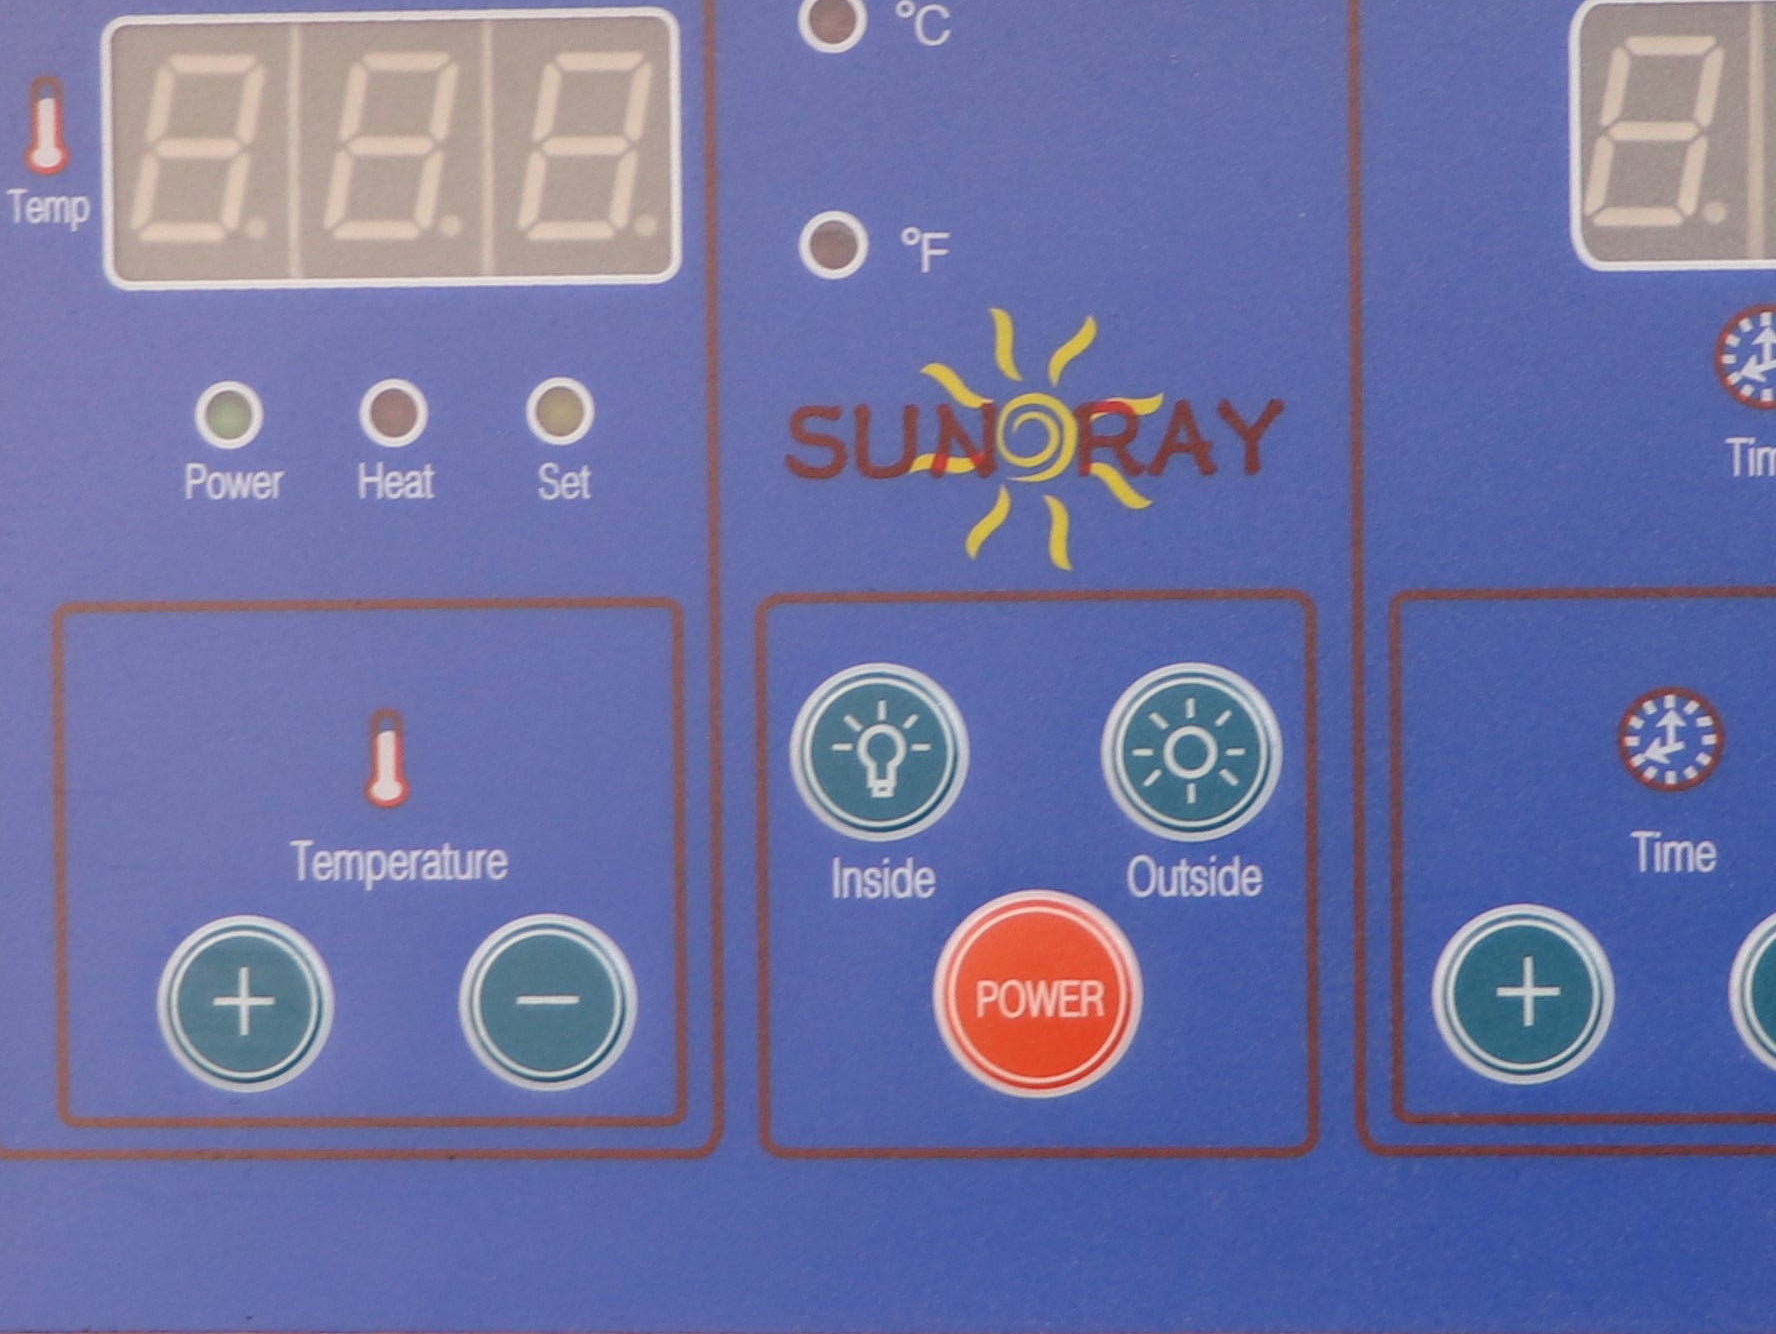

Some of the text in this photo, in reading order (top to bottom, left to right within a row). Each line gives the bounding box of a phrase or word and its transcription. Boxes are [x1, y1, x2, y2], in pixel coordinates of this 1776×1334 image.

[6, 188, 91, 233] Temp
[184, 462, 285, 501] Power
[358, 461, 435, 501] Heat
[537, 461, 592, 501] Set
[289, 839, 509, 892] Temperature
[1630, 830, 1717, 873] Time
[831, 856, 936, 899] Inside
[1126, 854, 1263, 898] Outside
[975, 979, 1105, 1019] POWER
